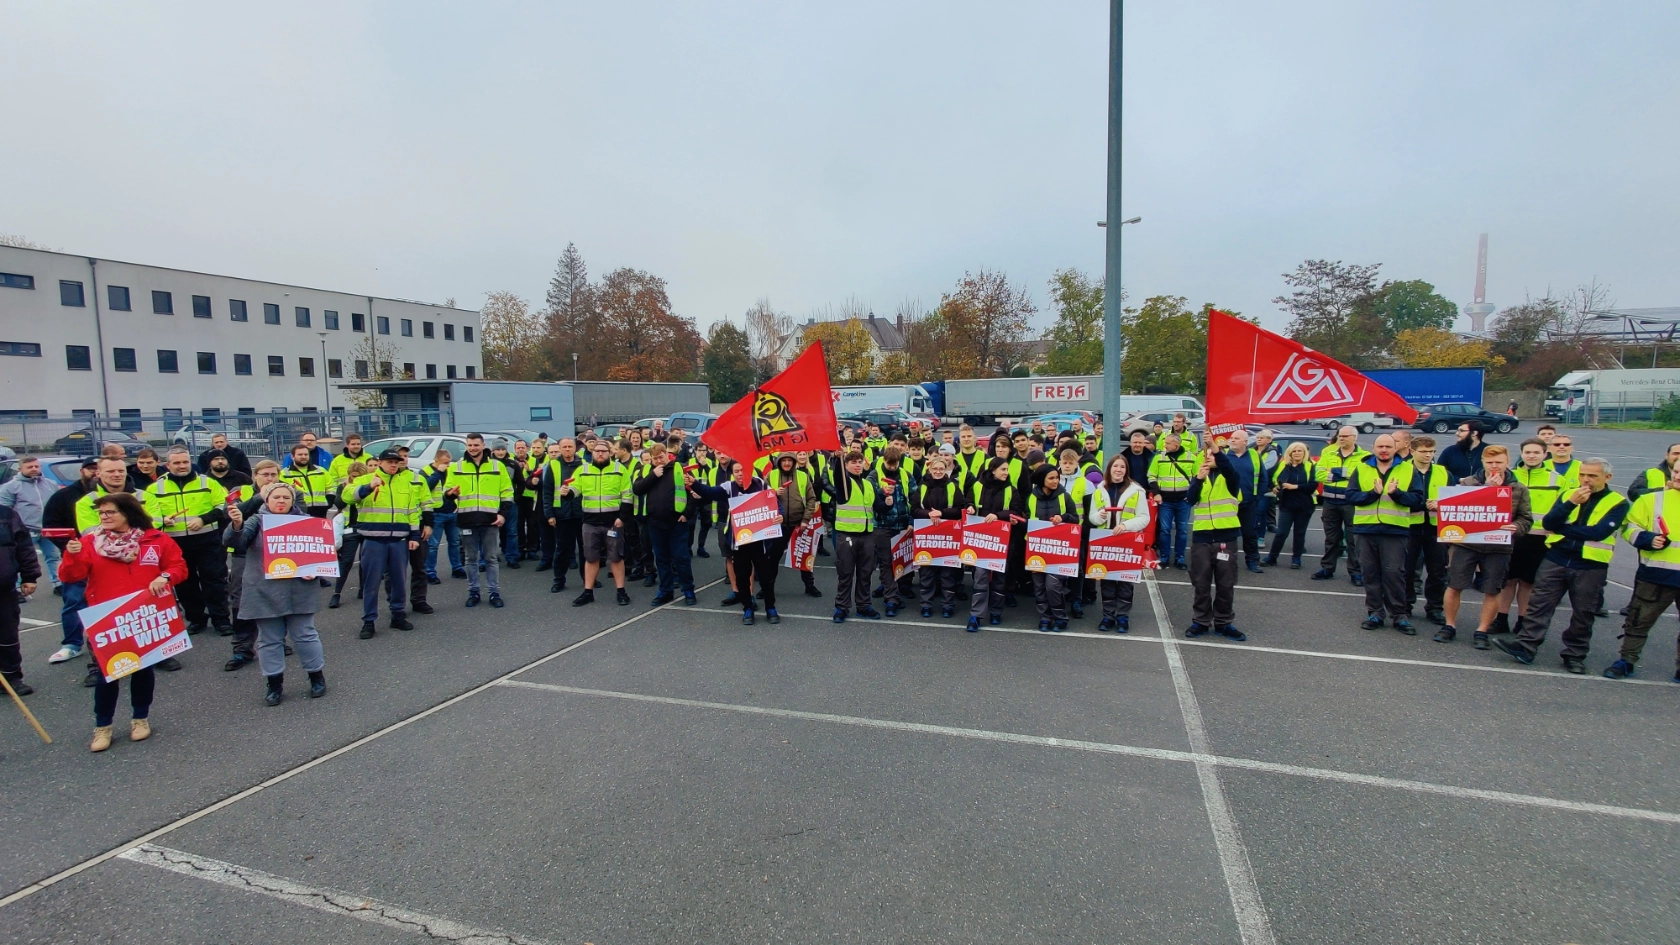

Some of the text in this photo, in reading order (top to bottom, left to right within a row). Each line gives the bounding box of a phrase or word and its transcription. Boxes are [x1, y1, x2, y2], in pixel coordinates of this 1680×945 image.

[1035, 385, 1085, 400] FREJA
[732, 512, 744, 520] WIR
[744, 507, 762, 517] HABEN
[734, 509, 778, 528] VERDIENT!
[1440, 512, 1509, 523] VERDIENT!
[266, 535, 285, 543] WIR
[286, 535, 314, 543] HABEN
[973, 532, 993, 541] HABEN
[1041, 537, 1062, 546] HABEN
[267, 542, 335, 555] VERDIENT!
[915, 540, 960, 550] VERDIENT!
[963, 536, 1007, 553] VERDIENT!
[1028, 543, 1078, 557] VERDIENT!
[892, 543, 914, 562] STREIT
[1089, 551, 1142, 565] VERDIENT!
[114, 603, 158, 627] DAFÜR
[94, 605, 178, 648] STREITEN
[134, 623, 172, 648] WIR
